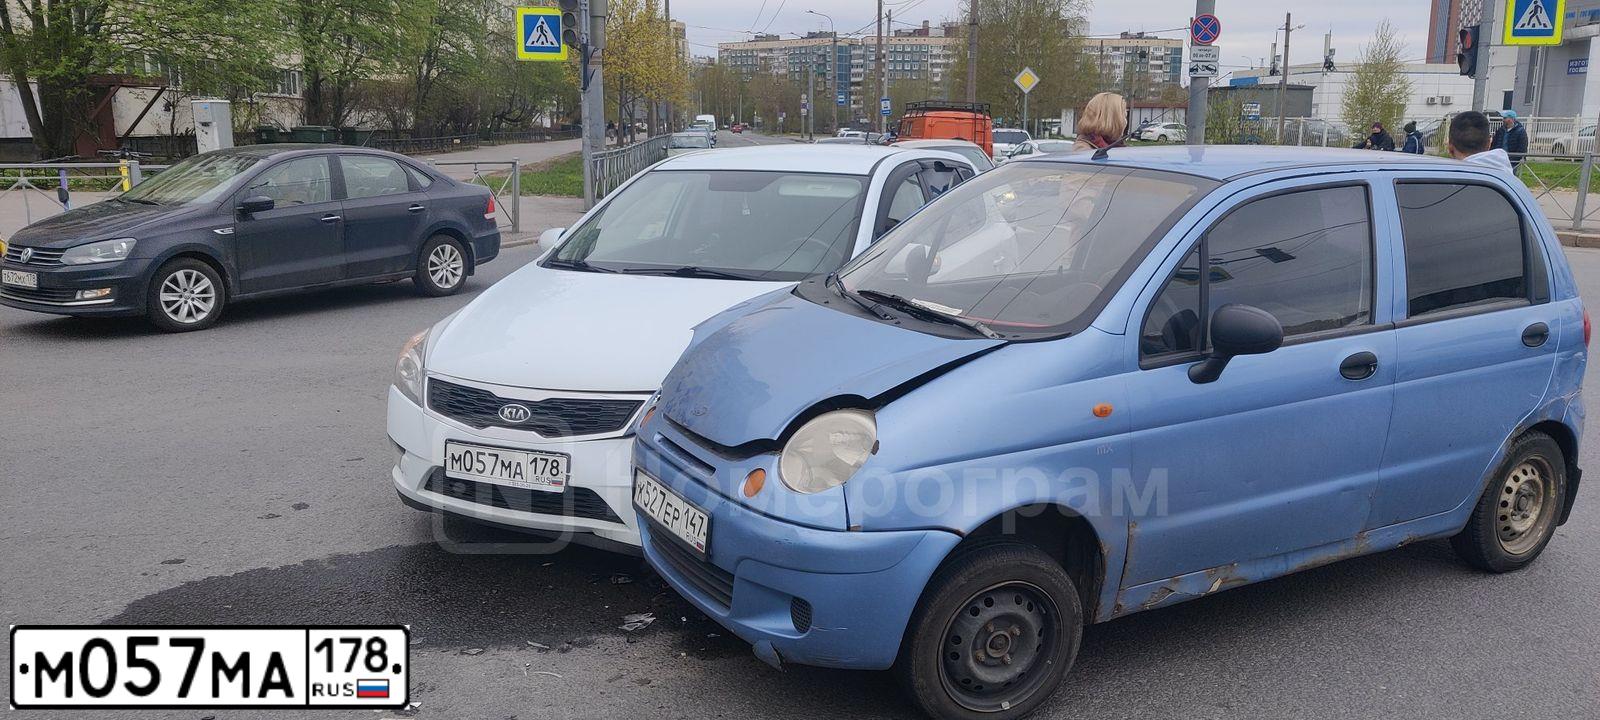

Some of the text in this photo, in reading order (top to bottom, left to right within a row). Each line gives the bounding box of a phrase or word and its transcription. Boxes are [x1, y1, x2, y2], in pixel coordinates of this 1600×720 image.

[503, 407, 525, 420] KIA
[451, 450, 560, 479] М057МА 178
[535, 476, 551, 484] RUS
[636, 474, 704, 537] К527ЕР 147
[686, 531, 697, 544] RUS
